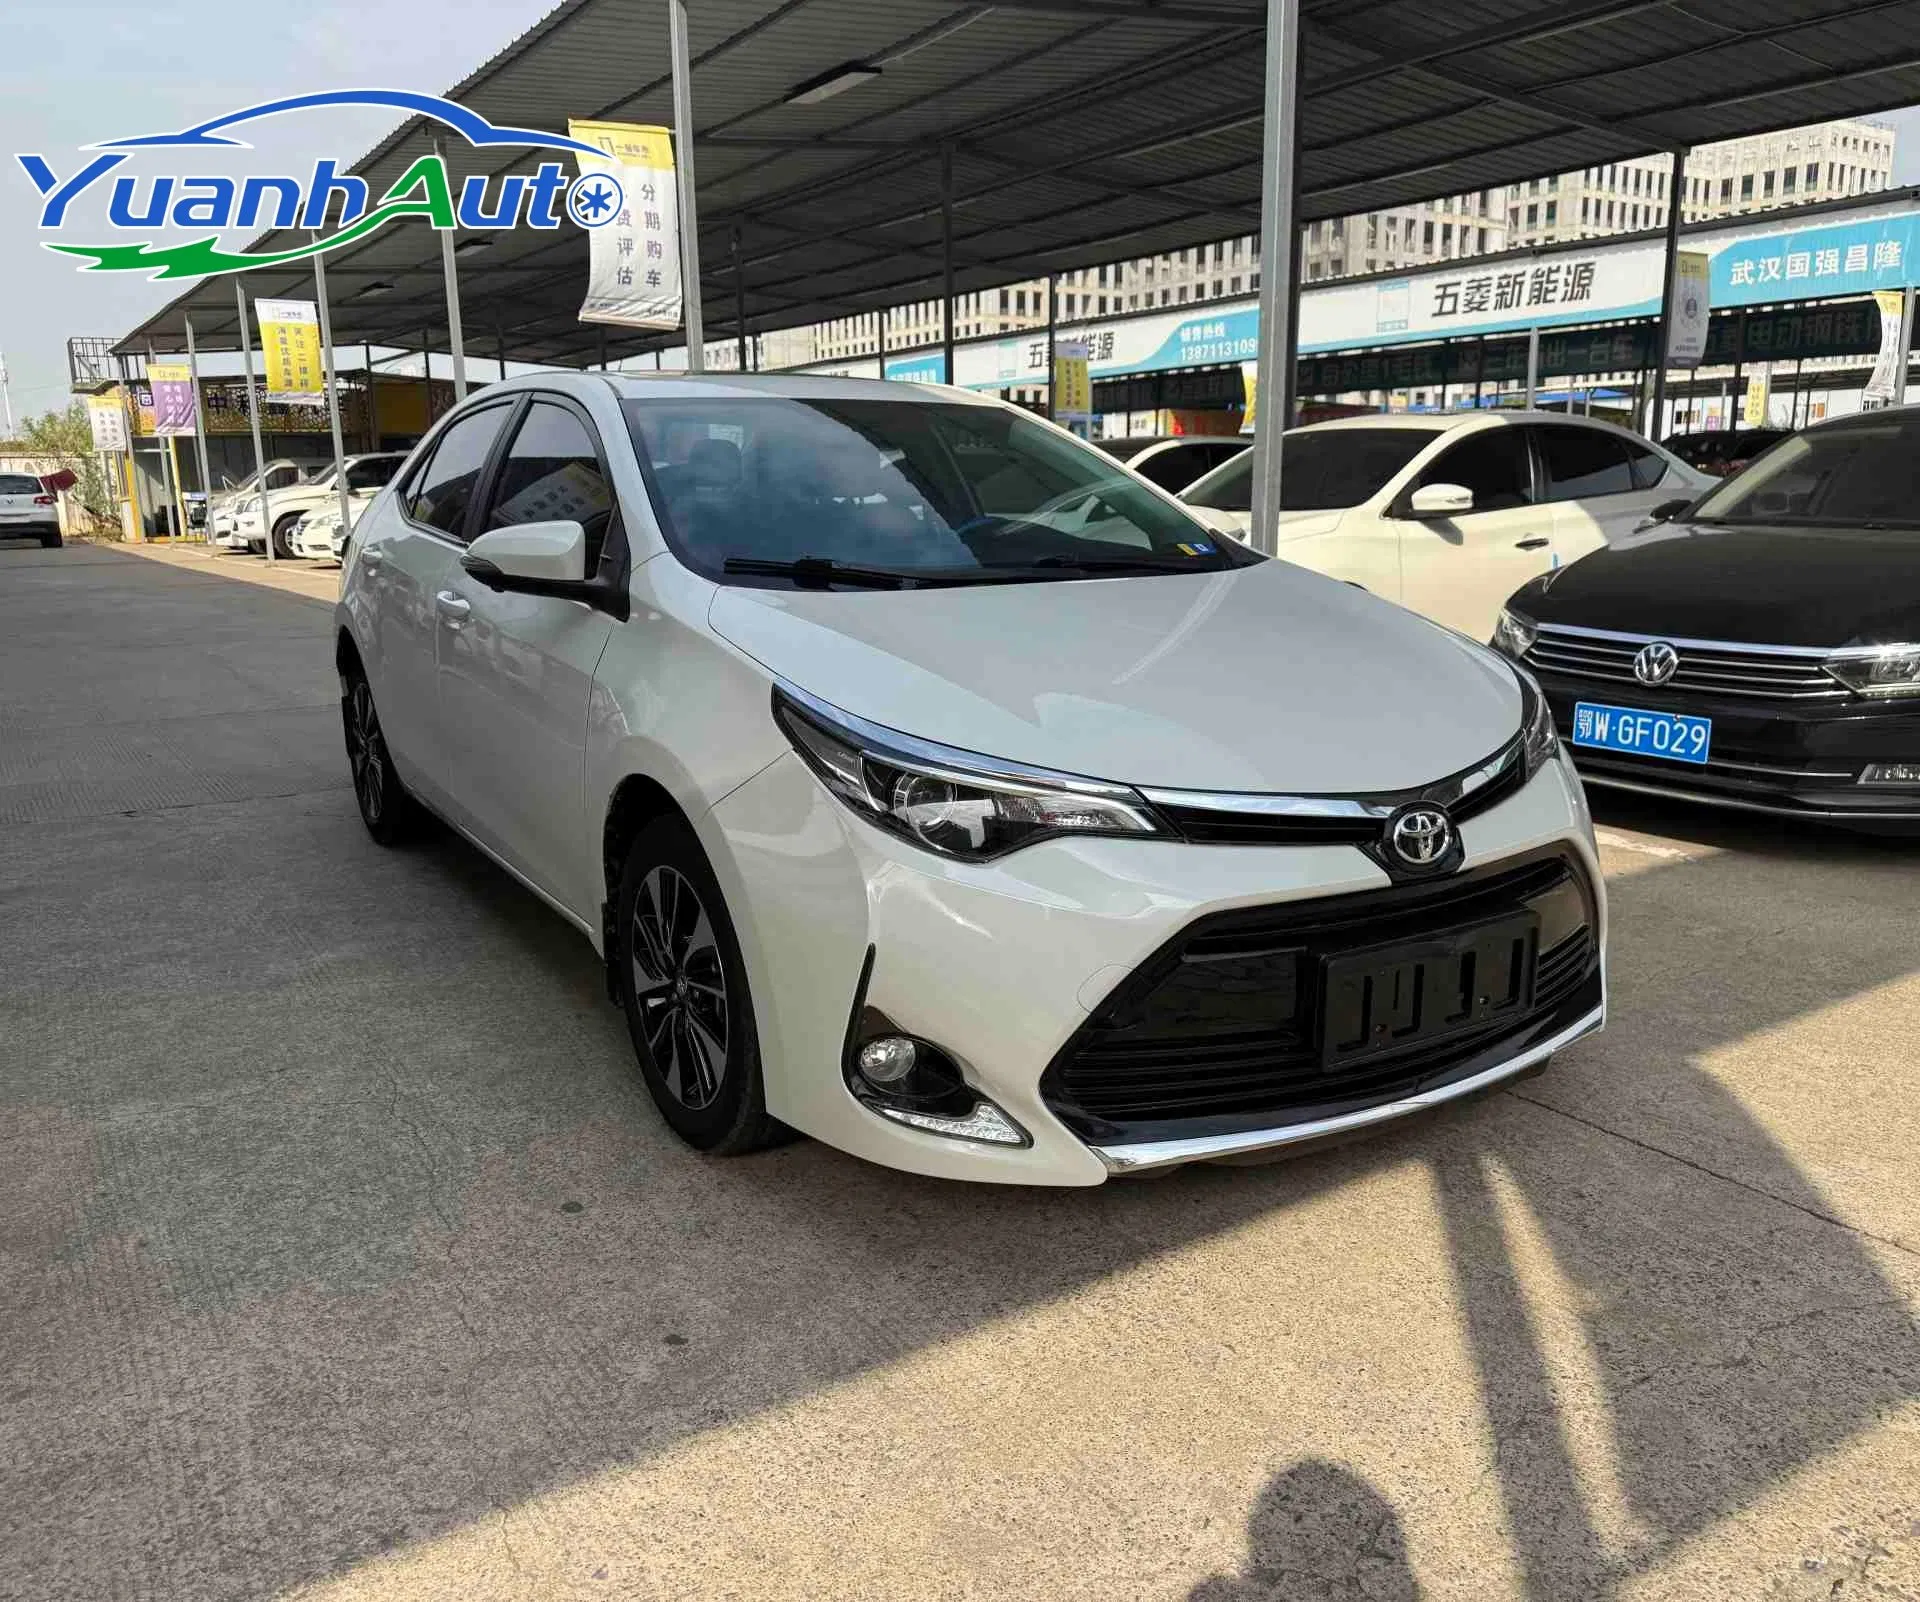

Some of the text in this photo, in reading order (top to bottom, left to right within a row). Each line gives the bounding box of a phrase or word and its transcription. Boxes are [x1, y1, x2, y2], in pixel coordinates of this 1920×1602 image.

[616, 184, 634, 287] 费评估
[641, 183, 663, 288] 分期购车
[1729, 240, 1903, 286] 武汉国强昌隆
[1431, 261, 1596, 317] 五菱新能源
